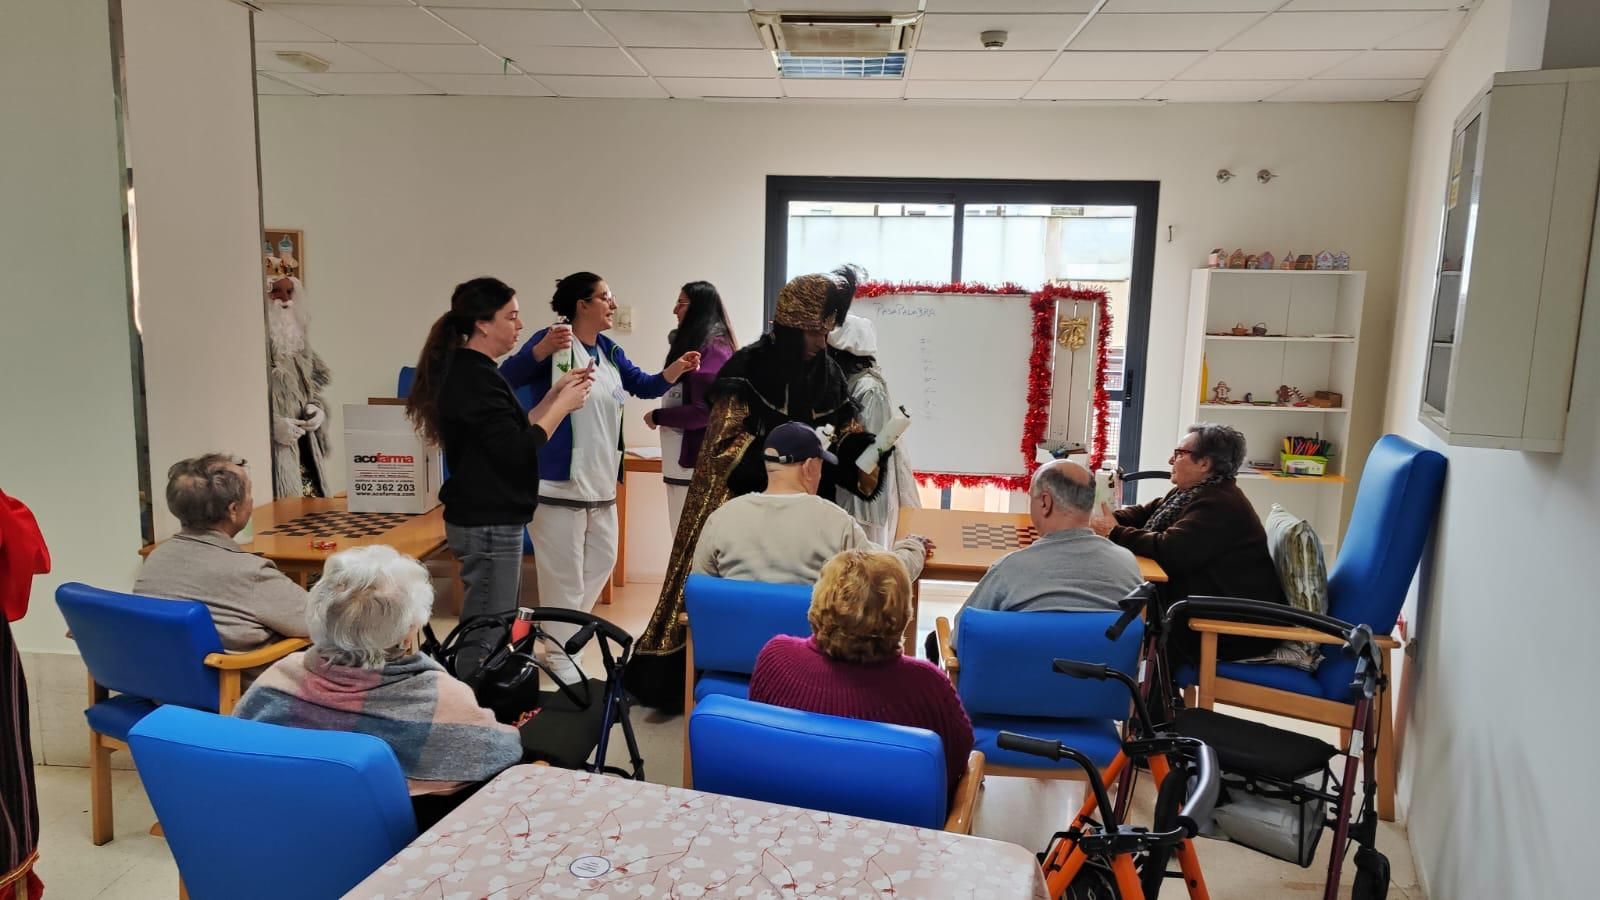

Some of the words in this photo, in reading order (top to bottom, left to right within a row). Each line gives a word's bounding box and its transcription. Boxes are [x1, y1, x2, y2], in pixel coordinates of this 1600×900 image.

[354, 452, 414, 463] acofarma
[355, 483, 373, 491] 902
[376, 483, 394, 491] 362
[397, 483, 415, 492] 203
